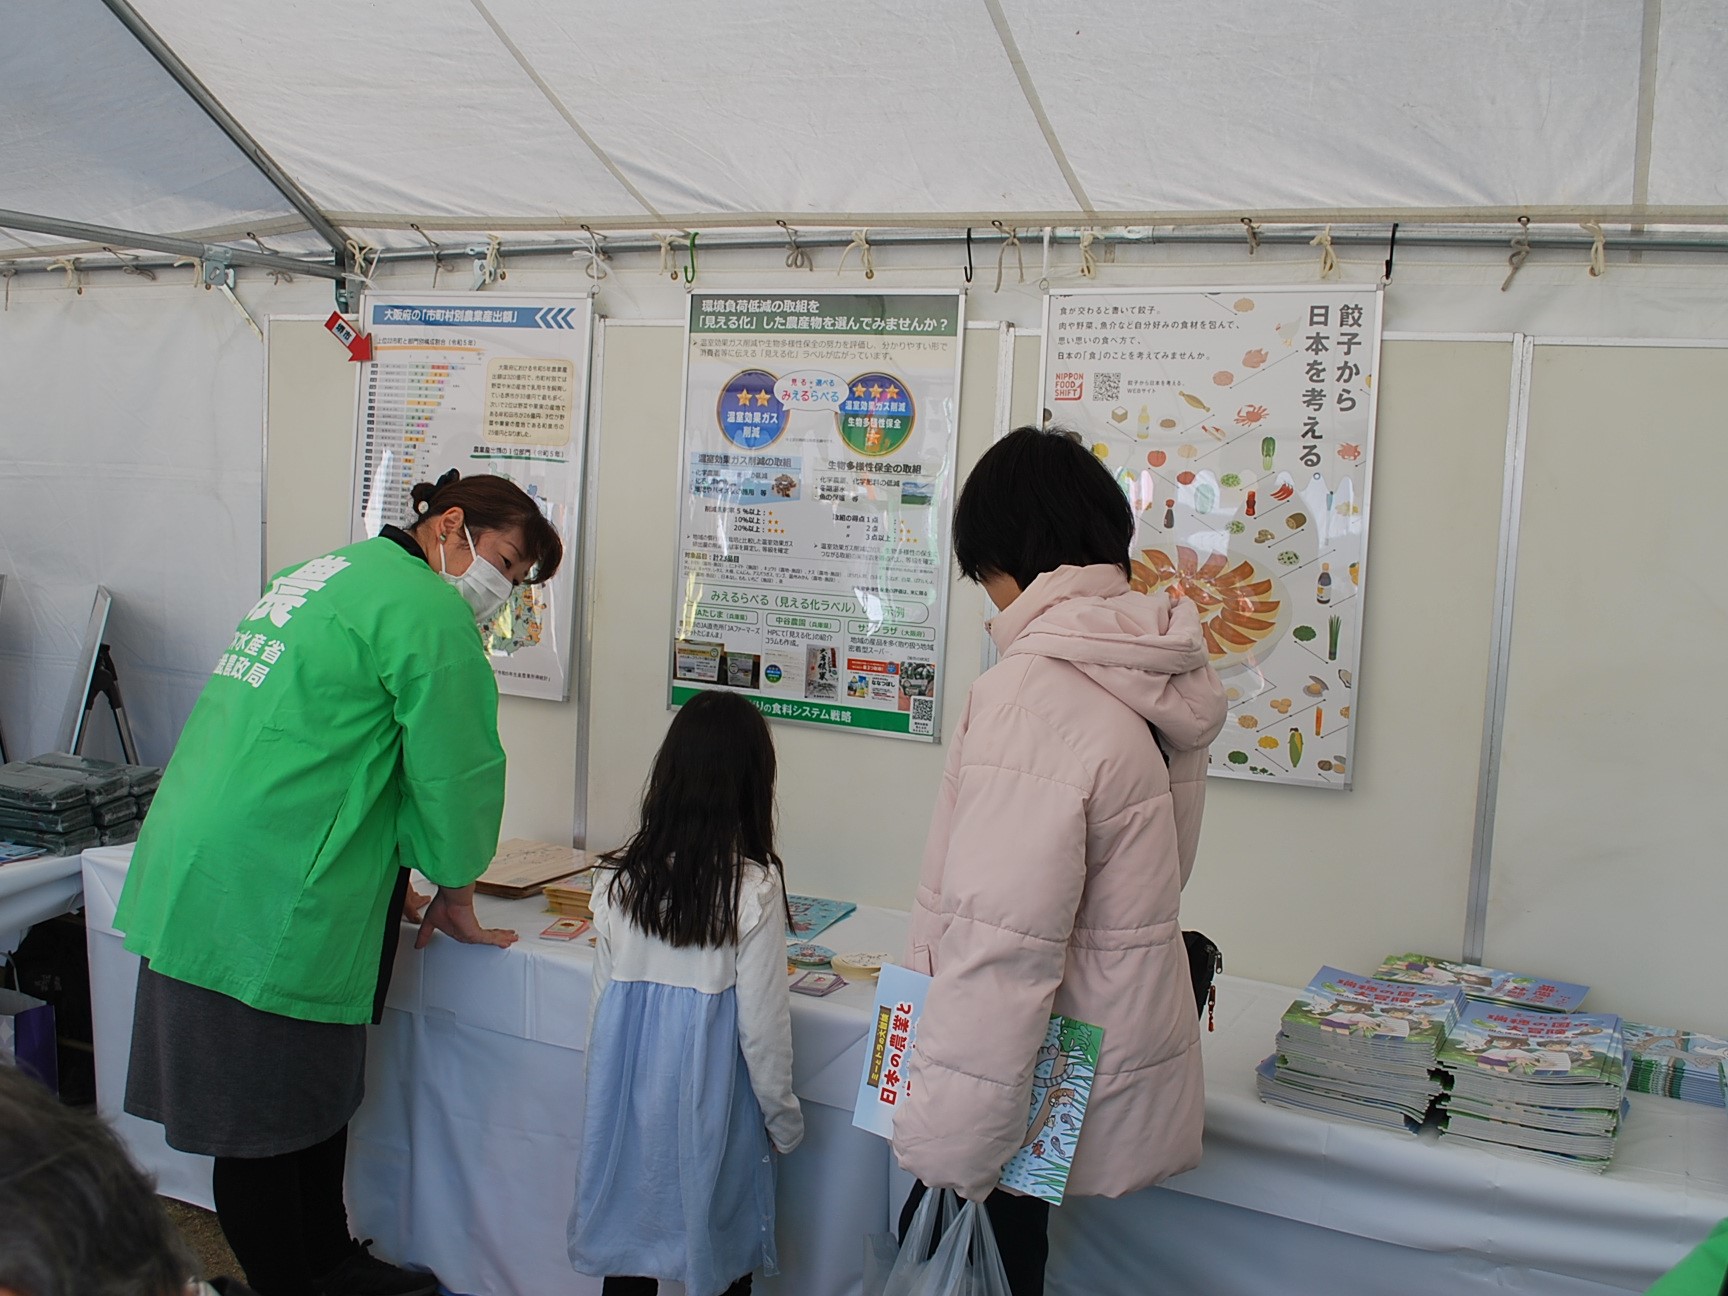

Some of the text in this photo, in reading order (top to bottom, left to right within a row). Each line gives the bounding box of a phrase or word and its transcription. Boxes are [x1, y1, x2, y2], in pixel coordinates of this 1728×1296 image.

[701, 299, 820, 314] 環境負荷低減の取組を
[1060, 305, 1161, 316] 食が交わると書いて餃子。
[1335, 303, 1364, 413] 餃子から
[1055, 380, 1076, 389] FOOD
[781, 390, 840, 402] みえるらべる
[1055, 389, 1078, 397] SHIFT
[845, 400, 907, 413] 温室効果ガス削減
[727, 411, 779, 424] 温室効果ガス
[742, 426, 761, 438] 削減
[698, 453, 792, 468] 温室効果ガス削減の取組
[828, 460, 922, 474] 生物多様性保全の取組
[711, 590, 905, 618] みえるらべる（見える化ラベル）示例
[748, 700, 852, 723] りの食料システム戦略
[880, 1003, 912, 1106] 日本の農業と
